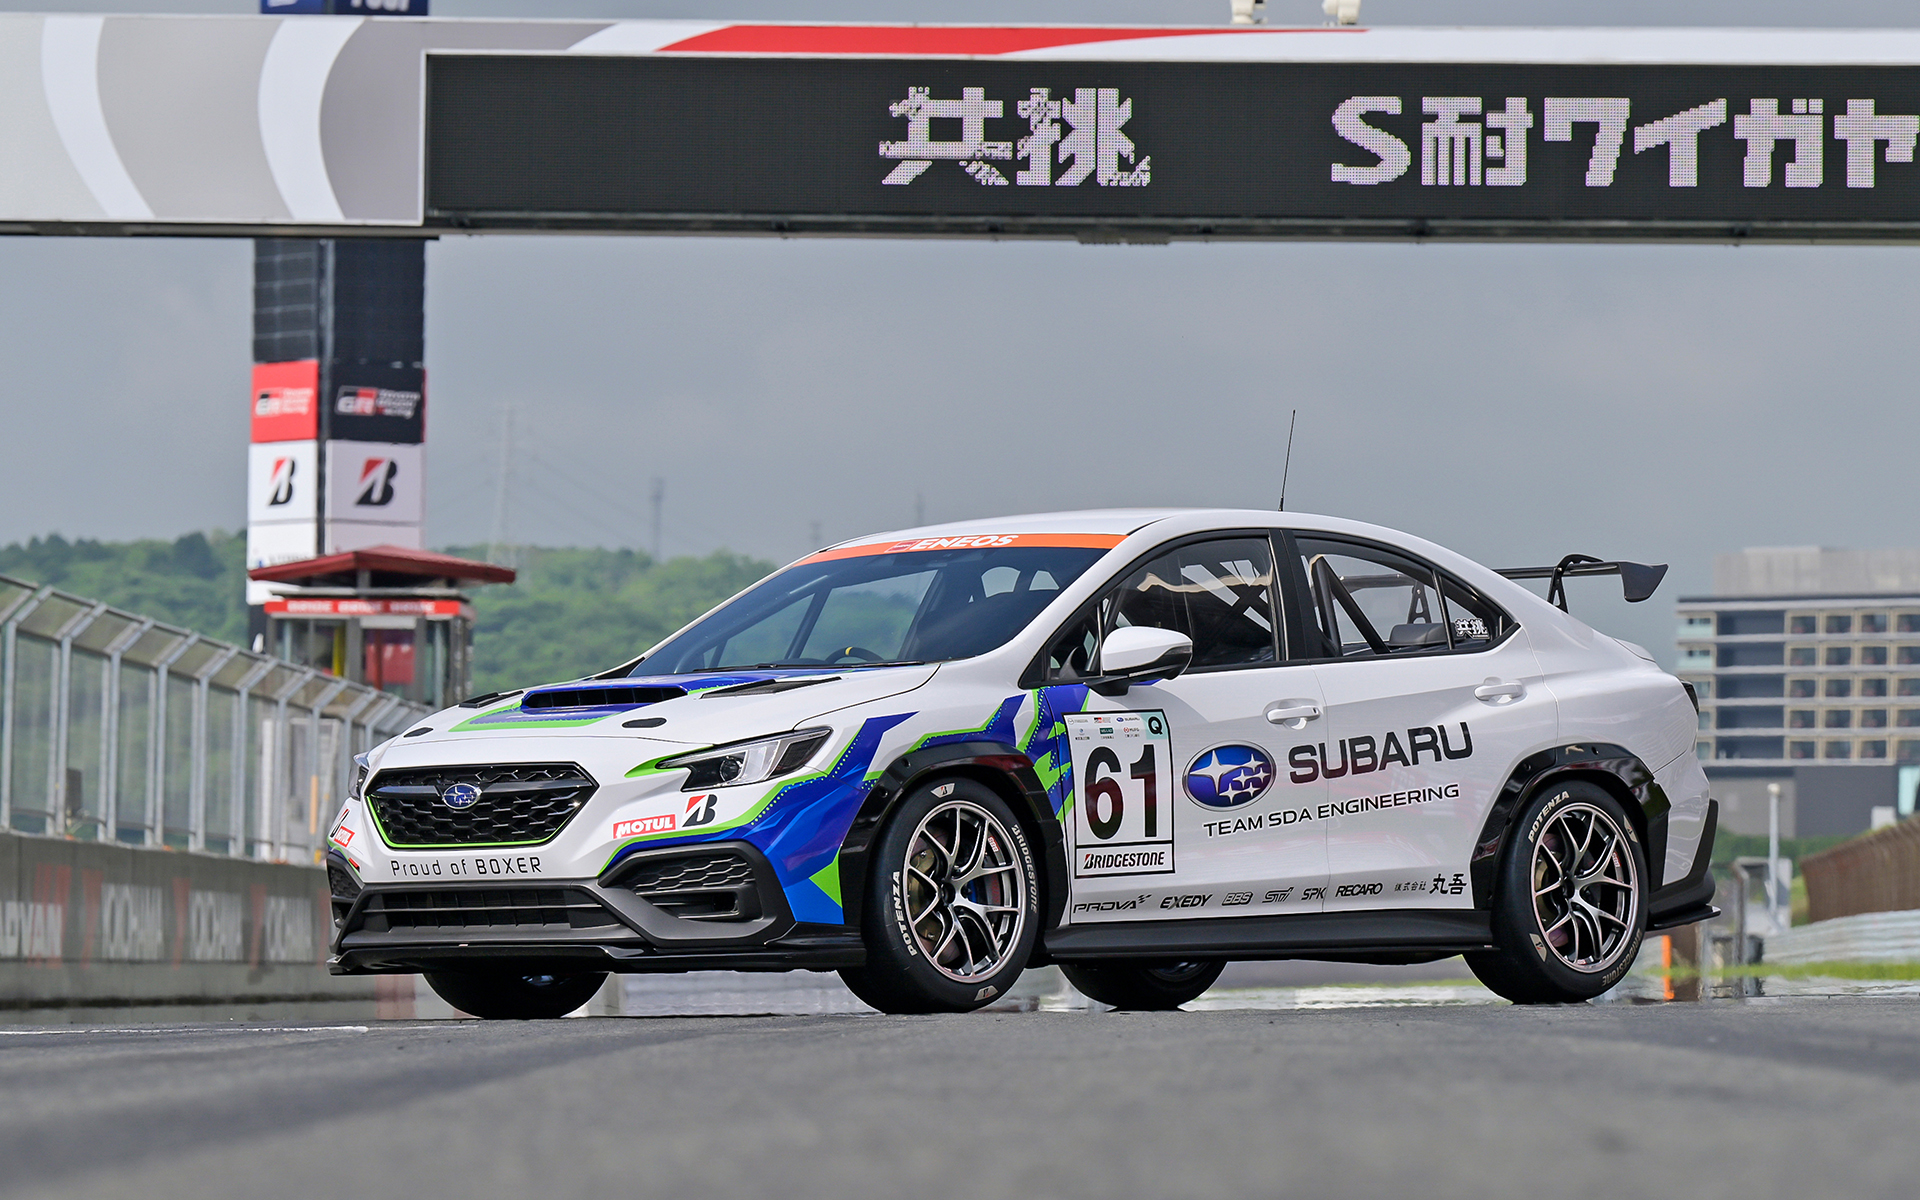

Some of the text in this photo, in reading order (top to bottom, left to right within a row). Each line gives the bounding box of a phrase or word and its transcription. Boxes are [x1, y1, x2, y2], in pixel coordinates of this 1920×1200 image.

[879, 86, 1919, 188] 共挑 S耐ワイガヤ
[909, 535, 1019, 550] ENEOS
[1147, 716, 1163, 735] Q
[1288, 722, 1473, 784] SUBARU
[1085, 744, 1157, 840] 61
[1203, 784, 1460, 837] TEAM SDA ENGINEERING
[615, 818, 674, 838] MOTUL
[1528, 790, 1570, 843] POTENZA
[391, 857, 542, 877] Proud of BOXER
[1012, 824, 1039, 914] BRIDGESTONE
[1083, 852, 1165, 870] BRIDGESTONE
[1073, 900, 1137, 913] PROVA
[1160, 894, 1213, 909] EXEDY
[1222, 892, 1253, 906] BBS
[1301, 887, 1326, 901] SPK
[1335, 882, 1384, 897] RECARO
[1429, 873, 1467, 895] 丸吾
[892, 871, 918, 956] POTENZA
